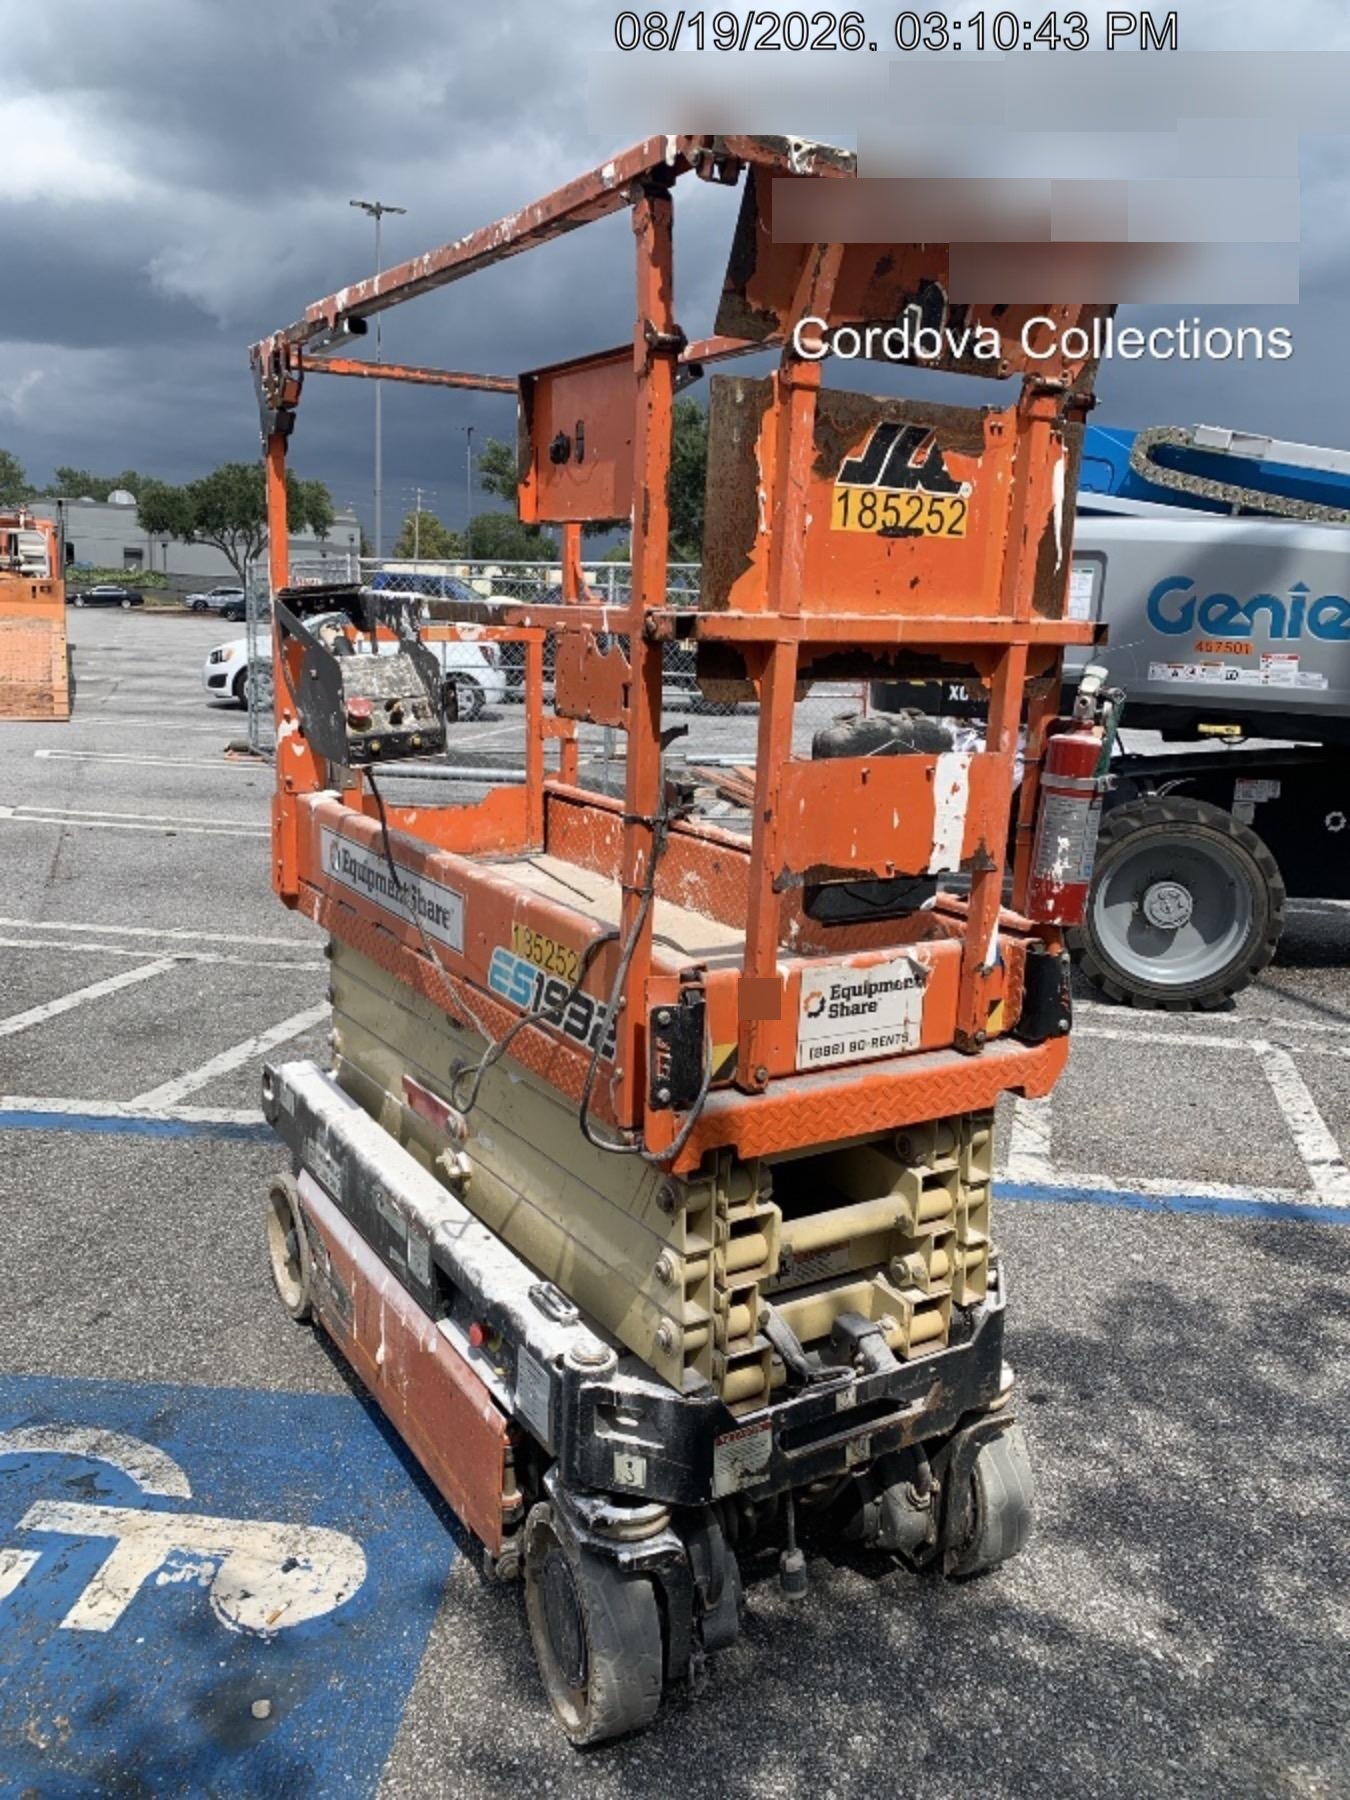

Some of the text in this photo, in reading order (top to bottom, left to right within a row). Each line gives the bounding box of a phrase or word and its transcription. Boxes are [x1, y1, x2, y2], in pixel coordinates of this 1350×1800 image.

[837, 488, 967, 536] 185252
[1146, 575, 1350, 642] Genie
[829, 974, 926, 1001] Equipment
[828, 1000, 878, 1019] Share
